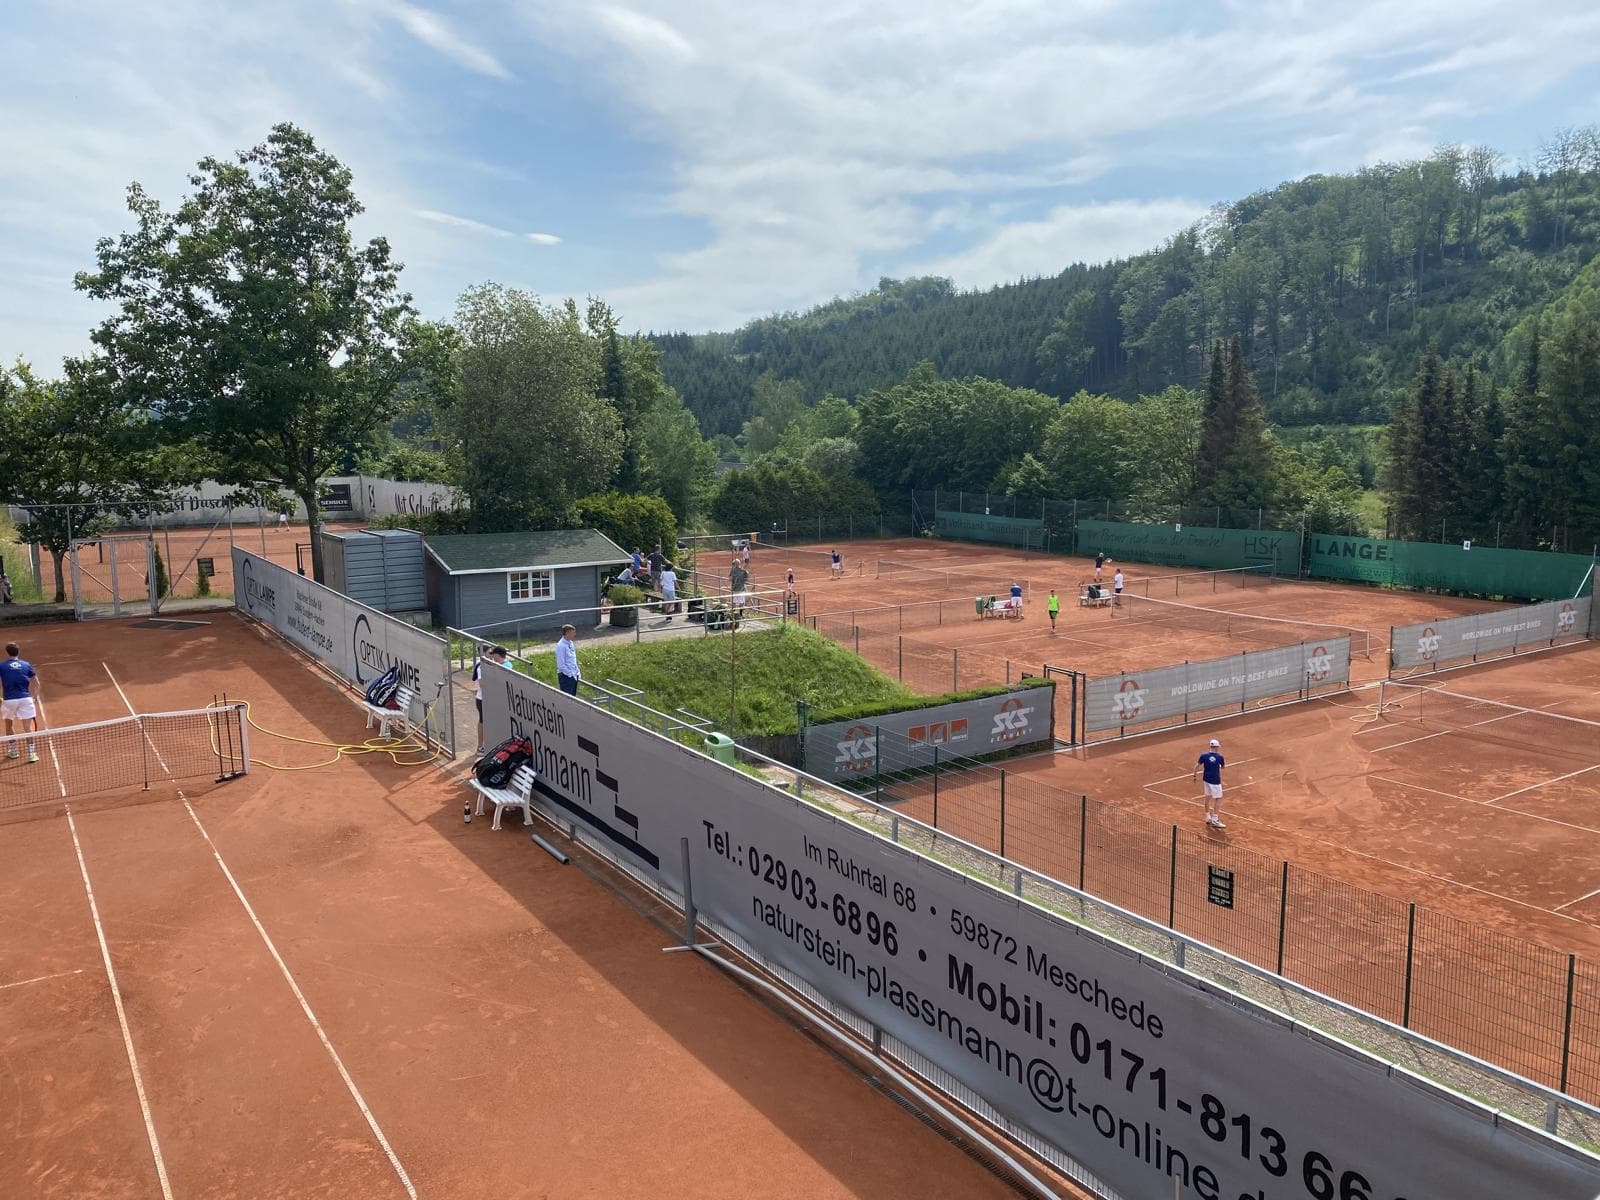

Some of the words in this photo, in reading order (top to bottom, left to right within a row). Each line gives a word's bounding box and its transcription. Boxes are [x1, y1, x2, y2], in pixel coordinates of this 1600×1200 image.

[1244, 536, 1281, 555] HSK
[360, 640, 386, 671] OPTIK
[1307, 654, 1333, 674] SKS
[1171, 680, 1216, 697] WORLDWIDE
[1218, 679, 1230, 689] ON
[1231, 675, 1246, 686] THE
[1247, 671, 1266, 682] BEST
[1268, 666, 1289, 679] BIKES
[506, 681, 566, 739] Naturstein
[1112, 688, 1146, 711] SKS
[992, 708, 1030, 734] SKS
[511, 717, 592, 805] ßmann
[835, 736, 880, 763] SKS
[703, 820, 743, 867] Tel.:
[749, 846, 899, 957] 02903-6896
[948, 954, 1057, 1048] Mobil:
[803, 835, 823, 865] Im
[827, 848, 888, 898] Ruhrtal
[893, 882, 917, 913] 68
[950, 909, 1018, 965] 59872
[1027, 945, 1164, 1039] Meschede
[753, 896, 1265, 1200] naturstein-plassmann@t-online
